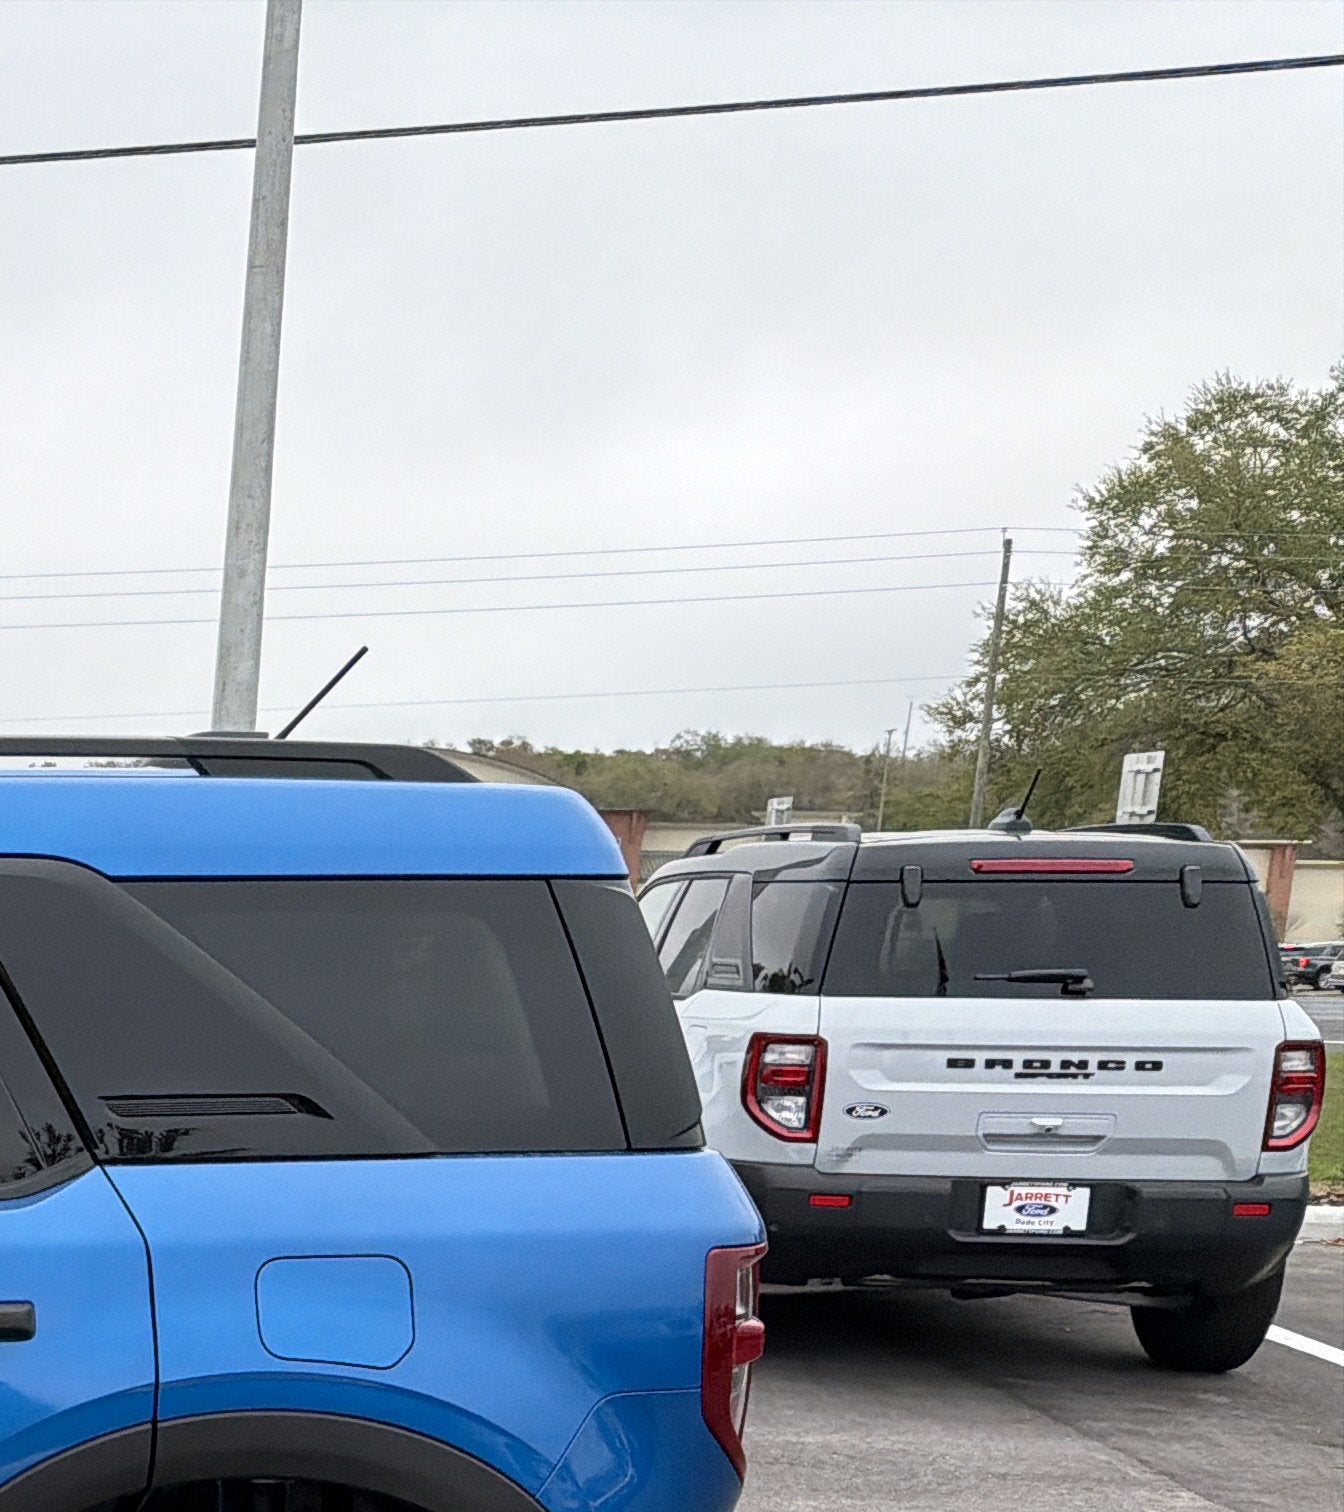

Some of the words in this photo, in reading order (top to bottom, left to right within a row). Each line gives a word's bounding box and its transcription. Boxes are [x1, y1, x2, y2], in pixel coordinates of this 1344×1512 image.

[946, 1057, 1164, 1072] BRONCO
[1013, 1072, 1096, 1080] SPORT
[1002, 1190, 1072, 1207] JARRETT
[1021, 1204, 1051, 1216] Ford
